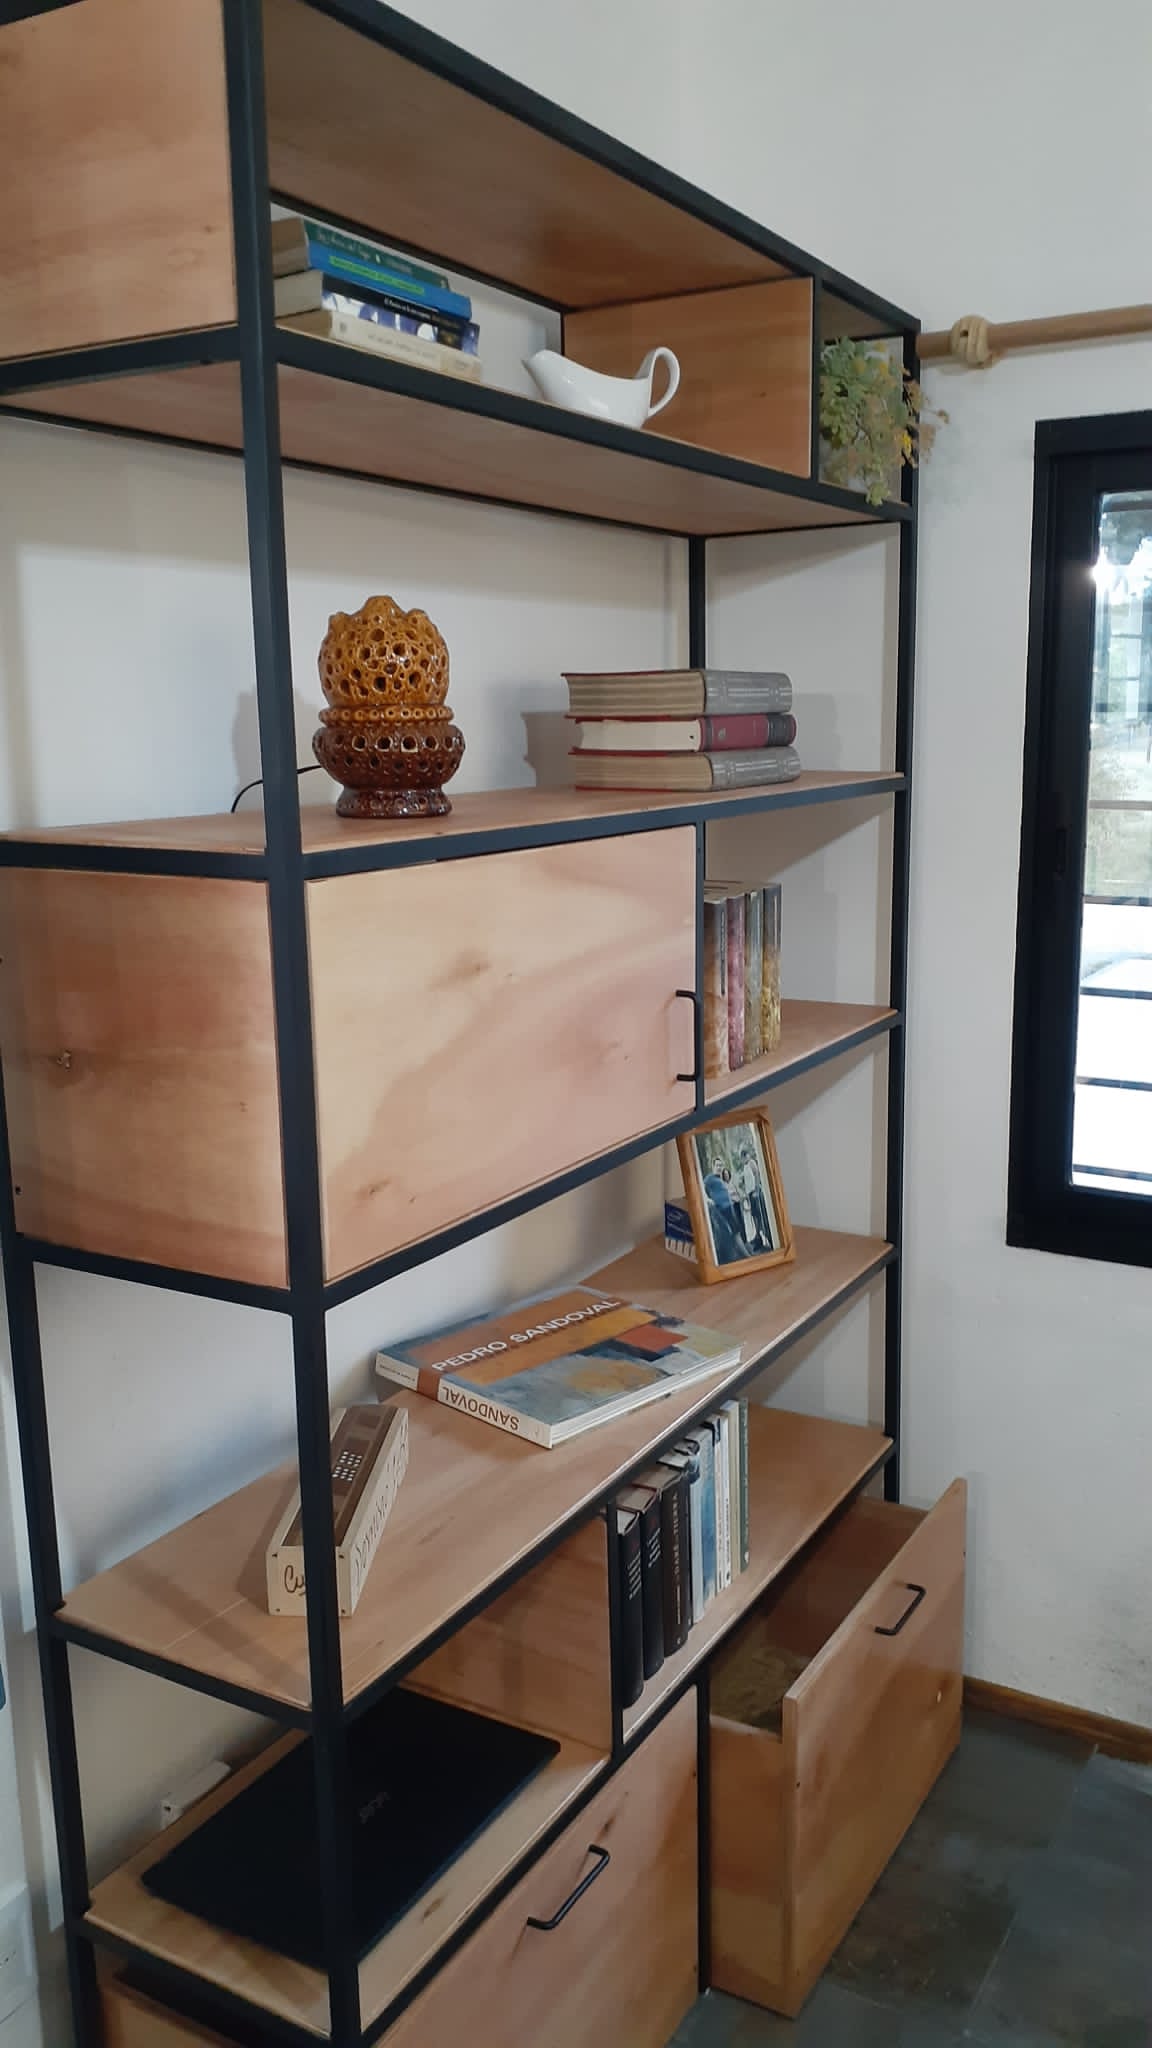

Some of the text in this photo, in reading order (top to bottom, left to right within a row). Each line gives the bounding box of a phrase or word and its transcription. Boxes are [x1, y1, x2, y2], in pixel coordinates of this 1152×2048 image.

[431, 1298, 621, 1372] PEDRO SANDOVAL
[442, 1385, 520, 1431] SANDOVAL
